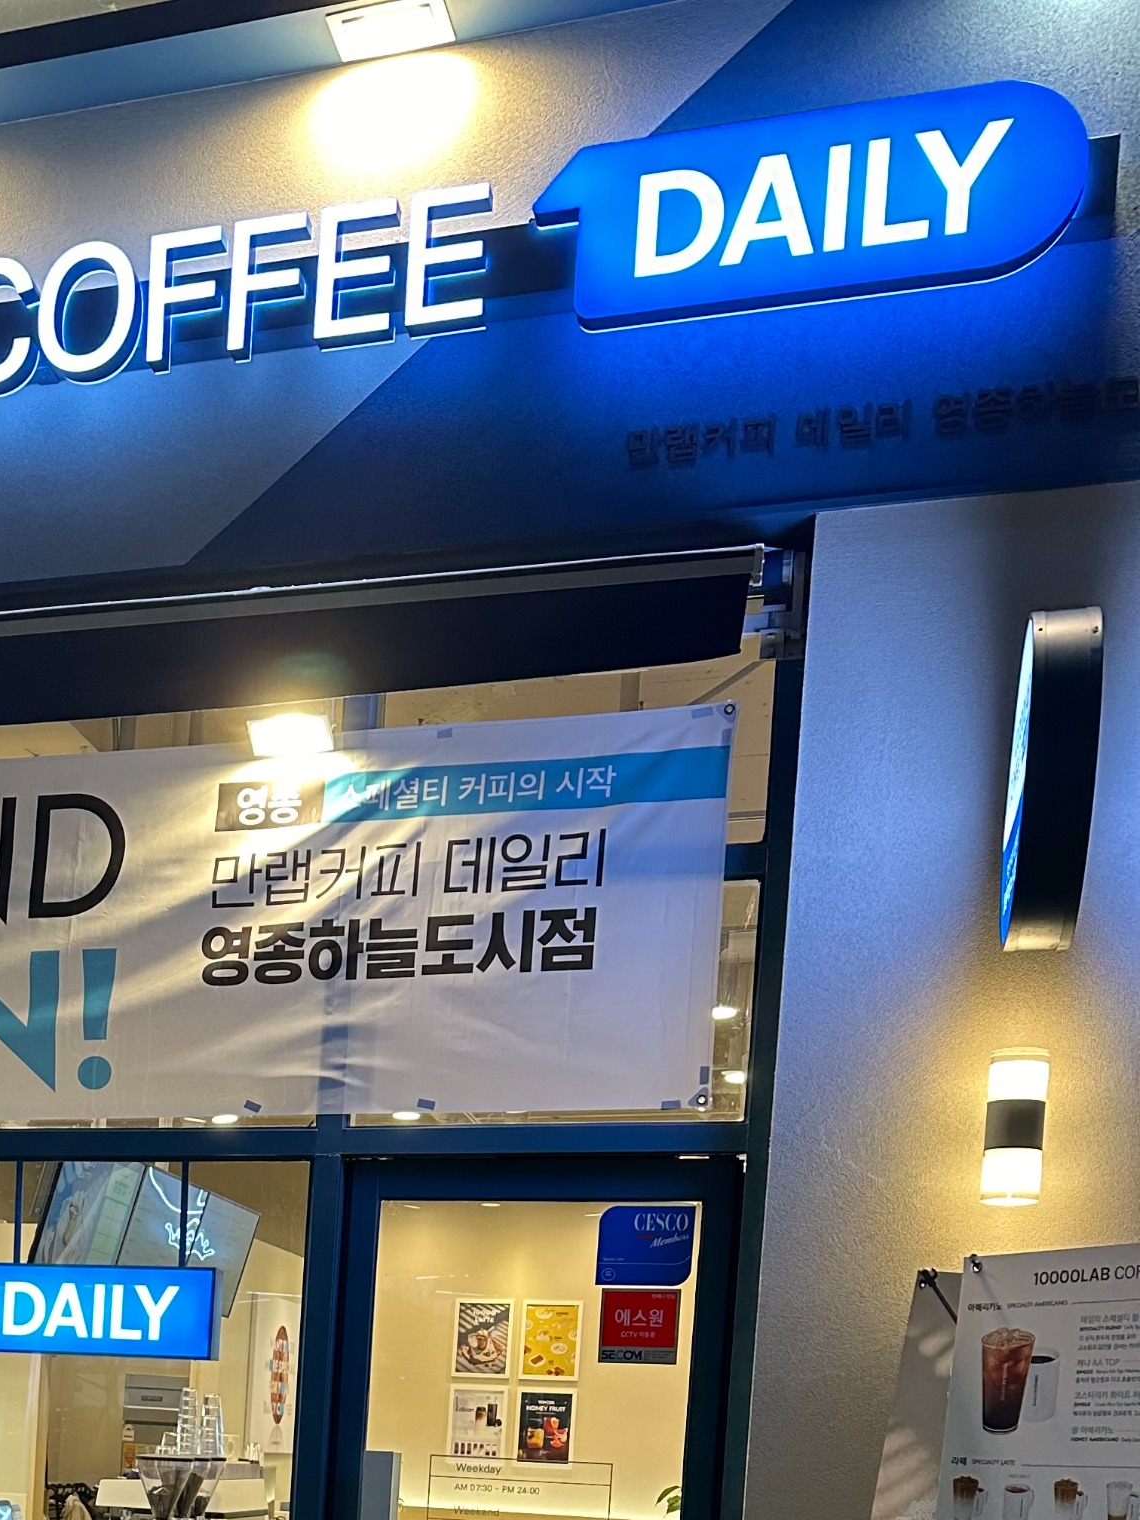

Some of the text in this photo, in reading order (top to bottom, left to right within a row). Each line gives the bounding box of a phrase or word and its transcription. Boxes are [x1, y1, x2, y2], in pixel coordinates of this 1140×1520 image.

[634, 117, 1014, 278] DAILY
[795, 398, 912, 454] 데일리
[236, 766, 617, 826] 영종 스페셜티 커피의 시작
[211, 828, 606, 910] 만랩커피 데일리
[201, 908, 597, 987] 영종하늘도시점
[634, 1213, 688, 1231] CESCO
[650, 1232, 689, 1248] Members
[1034, 1267, 1111, 1286] 10000LAB
[2, 1281, 180, 1341] DAILY
[968, 1302, 1002, 1312] 아메리카노
[615, 1309, 663, 1327] 에스원
[601, 1350, 642, 1360] SECOM
[456, 1462, 502, 1475] Weekday
[951, 1457, 967, 1465] 라떼
[454, 1483, 467, 1491] AM
[502, 1485, 515, 1494] PM
[453, 1505, 499, 1517] Weekend
